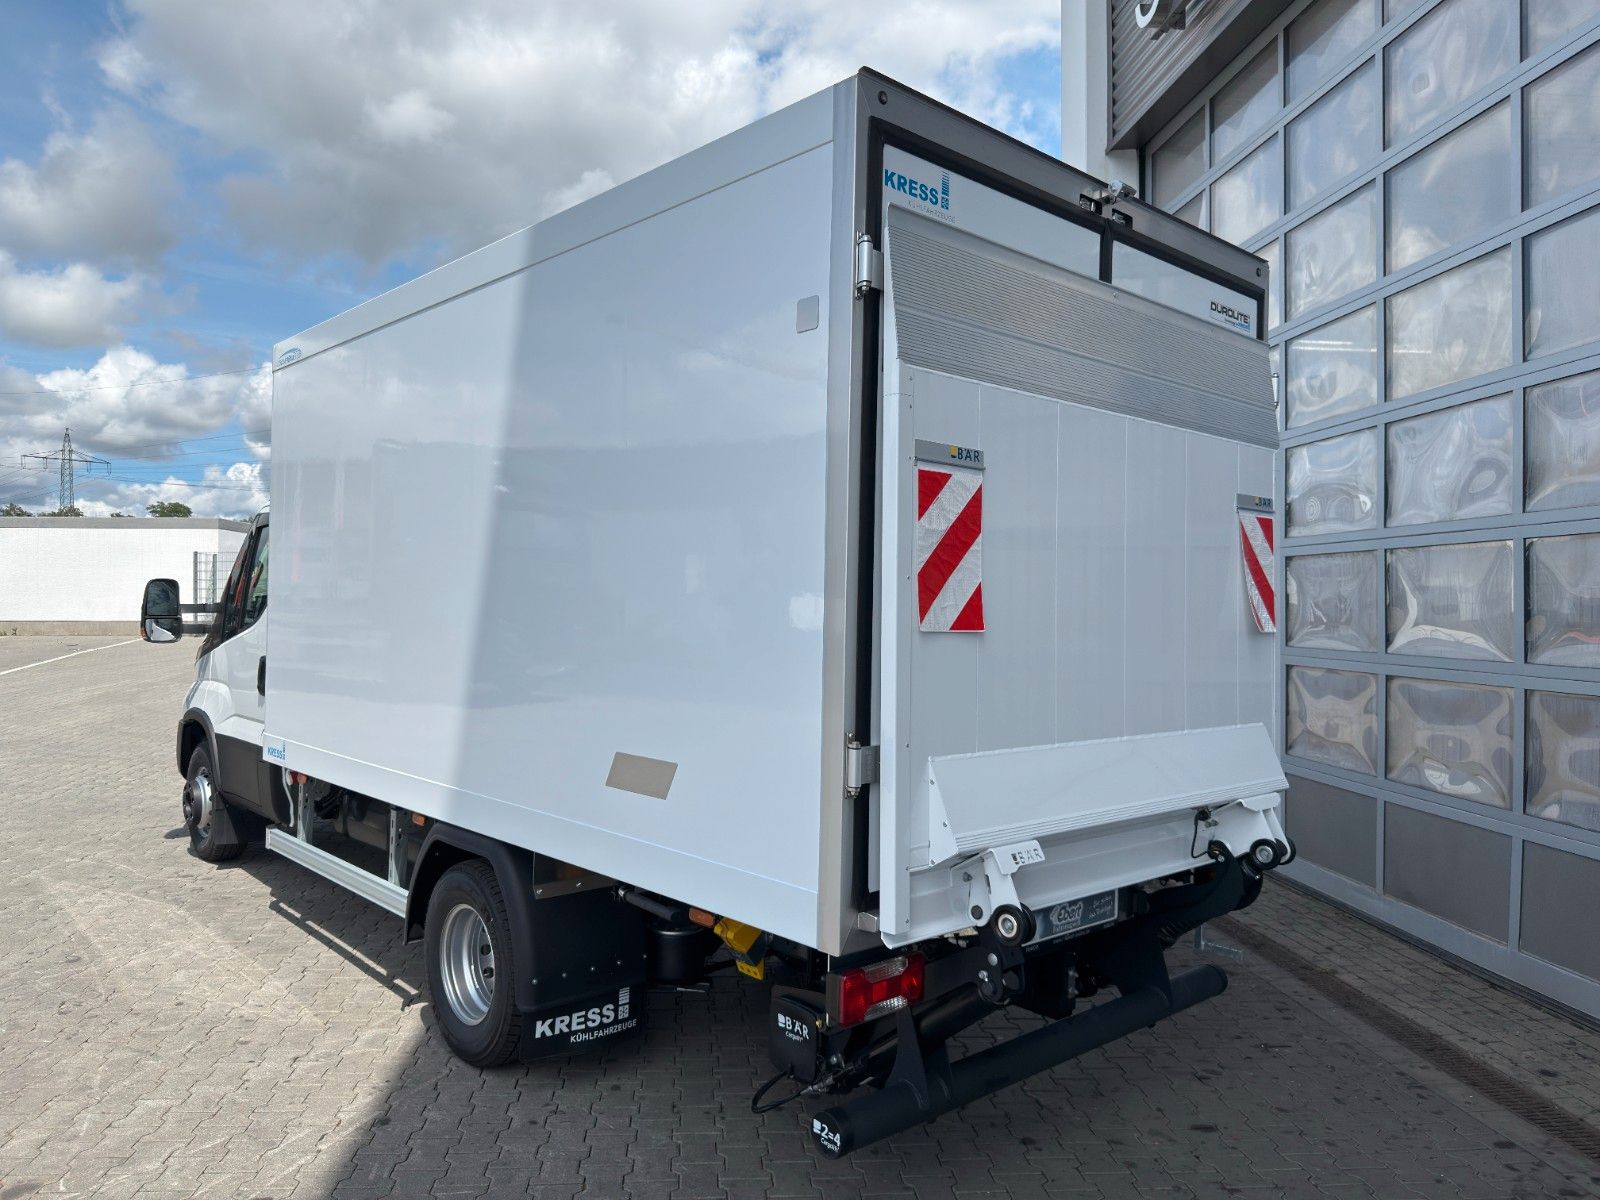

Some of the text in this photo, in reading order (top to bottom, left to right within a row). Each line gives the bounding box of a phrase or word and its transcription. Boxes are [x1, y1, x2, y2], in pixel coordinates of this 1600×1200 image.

[885, 169, 938, 206] KRESS
[958, 447, 980, 462] BÄR
[267, 746, 283, 759] KRESS
[535, 1003, 615, 1038] KRESS
[570, 1019, 637, 1043] KÜHLFAHRZEUGE
[786, 1016, 809, 1040] BÄR
[821, 1123, 840, 1147] 2=4
